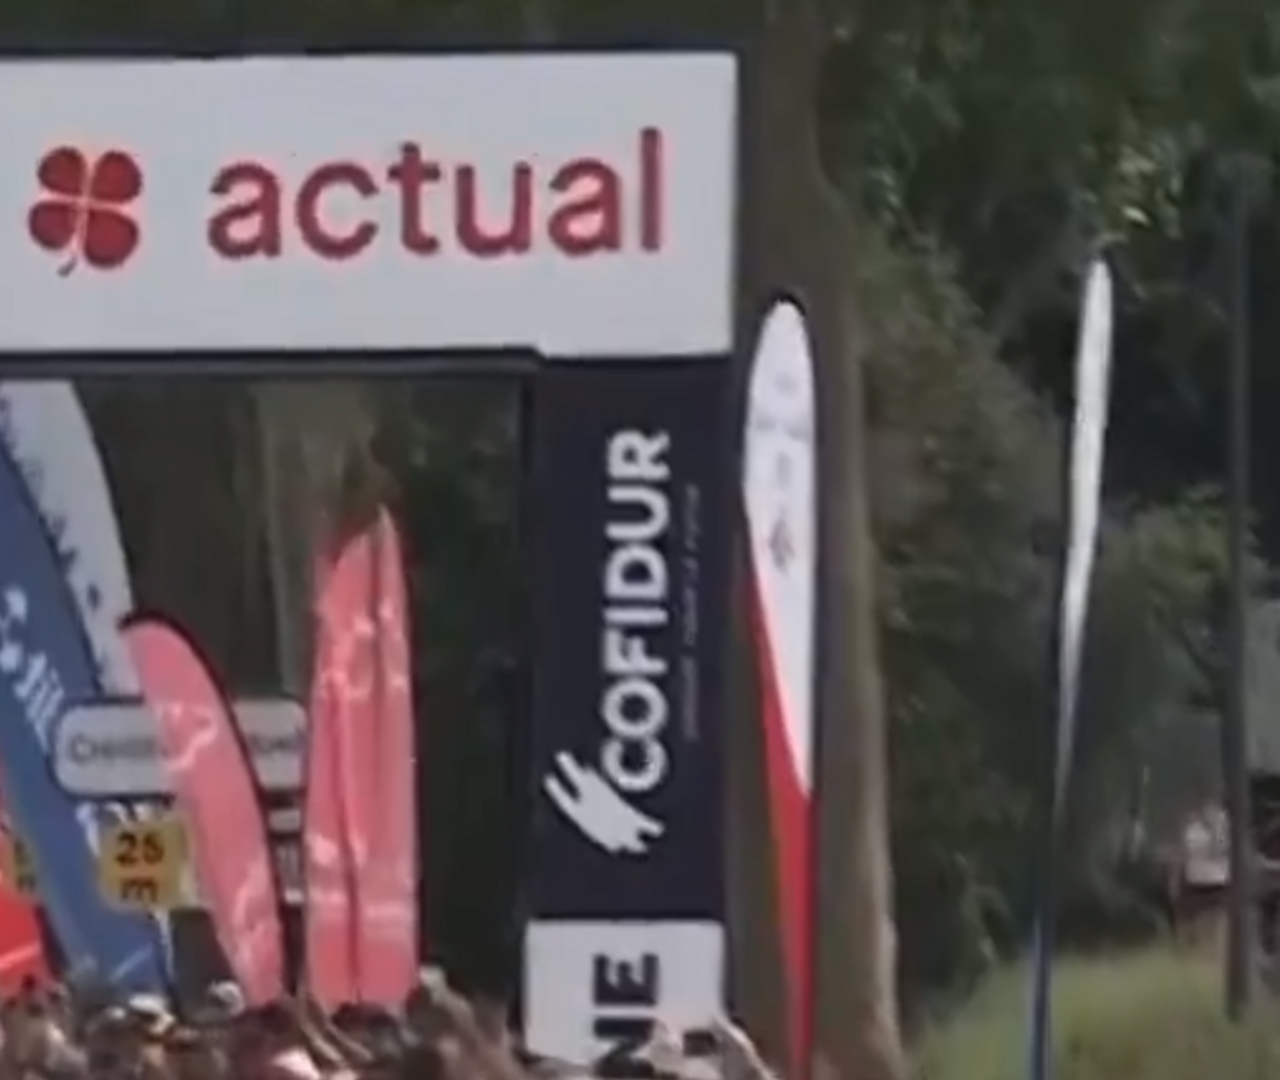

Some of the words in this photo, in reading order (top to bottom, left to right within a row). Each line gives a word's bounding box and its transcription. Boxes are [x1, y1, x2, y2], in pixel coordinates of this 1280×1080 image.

[207, 126, 664, 261] actual
[600, 429, 671, 792] COFIDUR
[115, 832, 165, 866] 25
